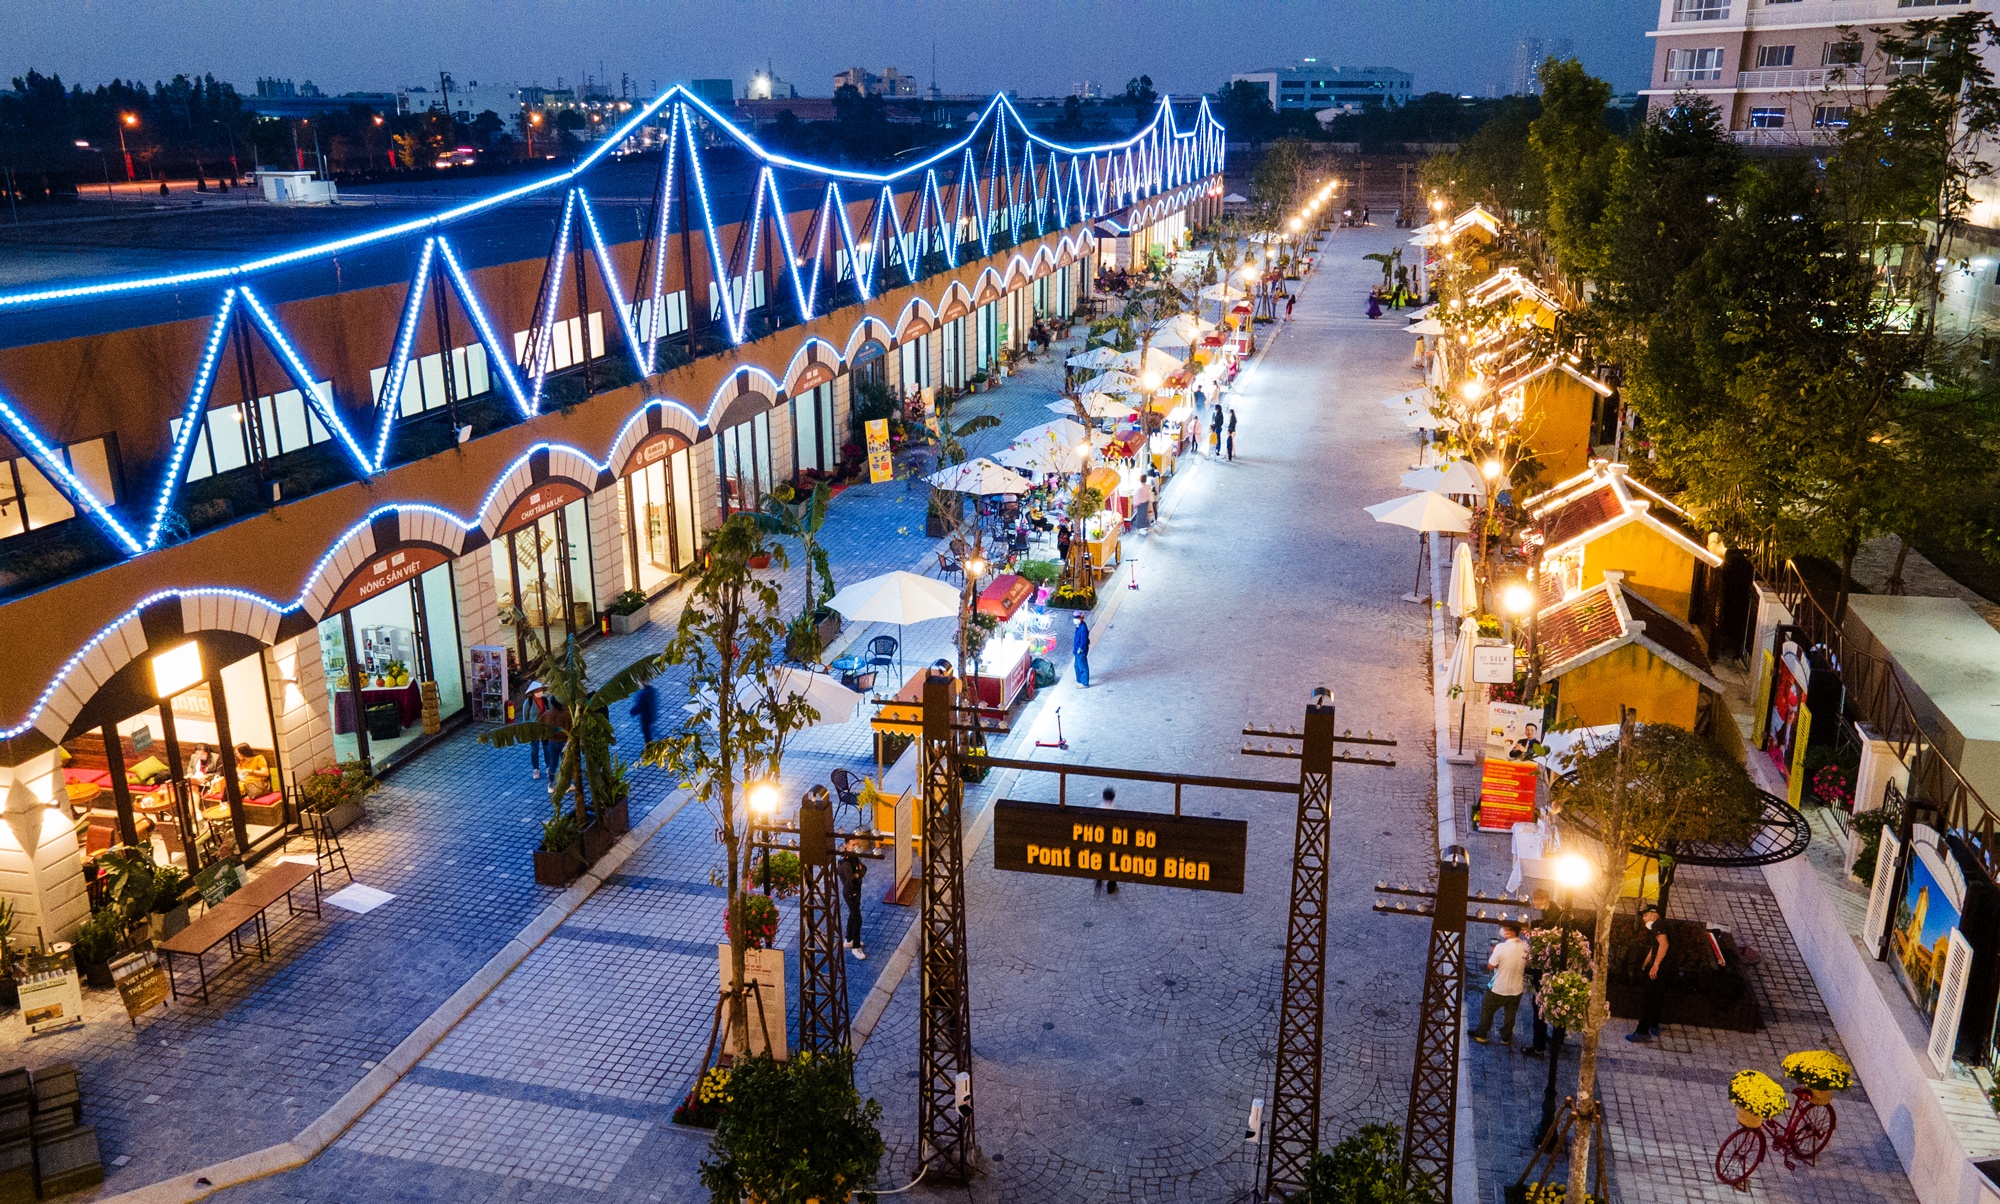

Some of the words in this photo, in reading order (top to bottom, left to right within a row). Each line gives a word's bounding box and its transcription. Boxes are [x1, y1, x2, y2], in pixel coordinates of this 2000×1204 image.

[359, 577, 386, 596] NÔNG
[403, 560, 421, 575] VIỆT
[1493, 707, 1517, 716] HDBank
[1072, 822, 1105, 844] PHO
[1112, 826, 1128, 846] DI
[1135, 829, 1156, 849] BO
[1027, 843, 1071, 868] Pont
[1078, 848, 1102, 871] de
[1109, 851, 1157, 878] Long
[1163, 856, 1211, 882] Bien
